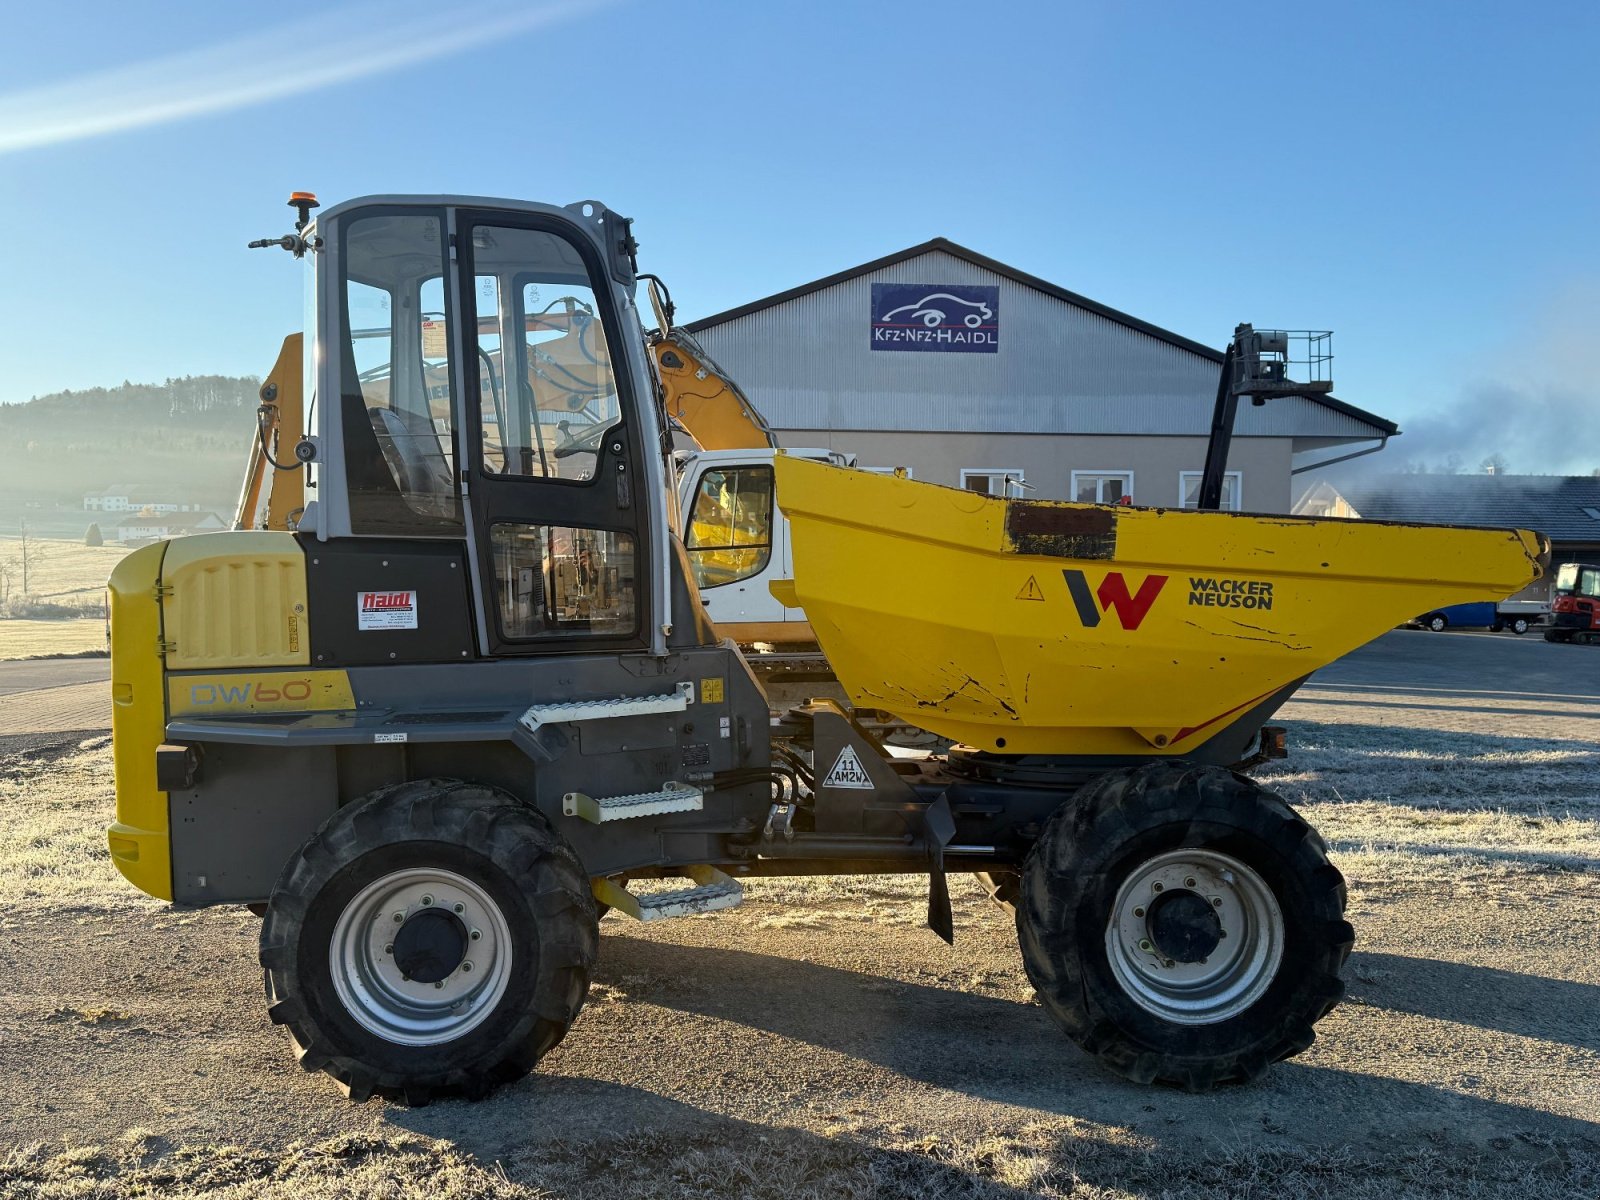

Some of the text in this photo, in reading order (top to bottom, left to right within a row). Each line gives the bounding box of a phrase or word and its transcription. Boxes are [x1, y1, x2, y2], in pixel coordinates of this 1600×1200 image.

[1189, 577, 1274, 596] WACKER
[1188, 592, 1273, 610] NEUSON
[191, 681, 311, 705] DW60
[842, 760, 854, 771] 11
[834, 772, 862, 783] AM2W
